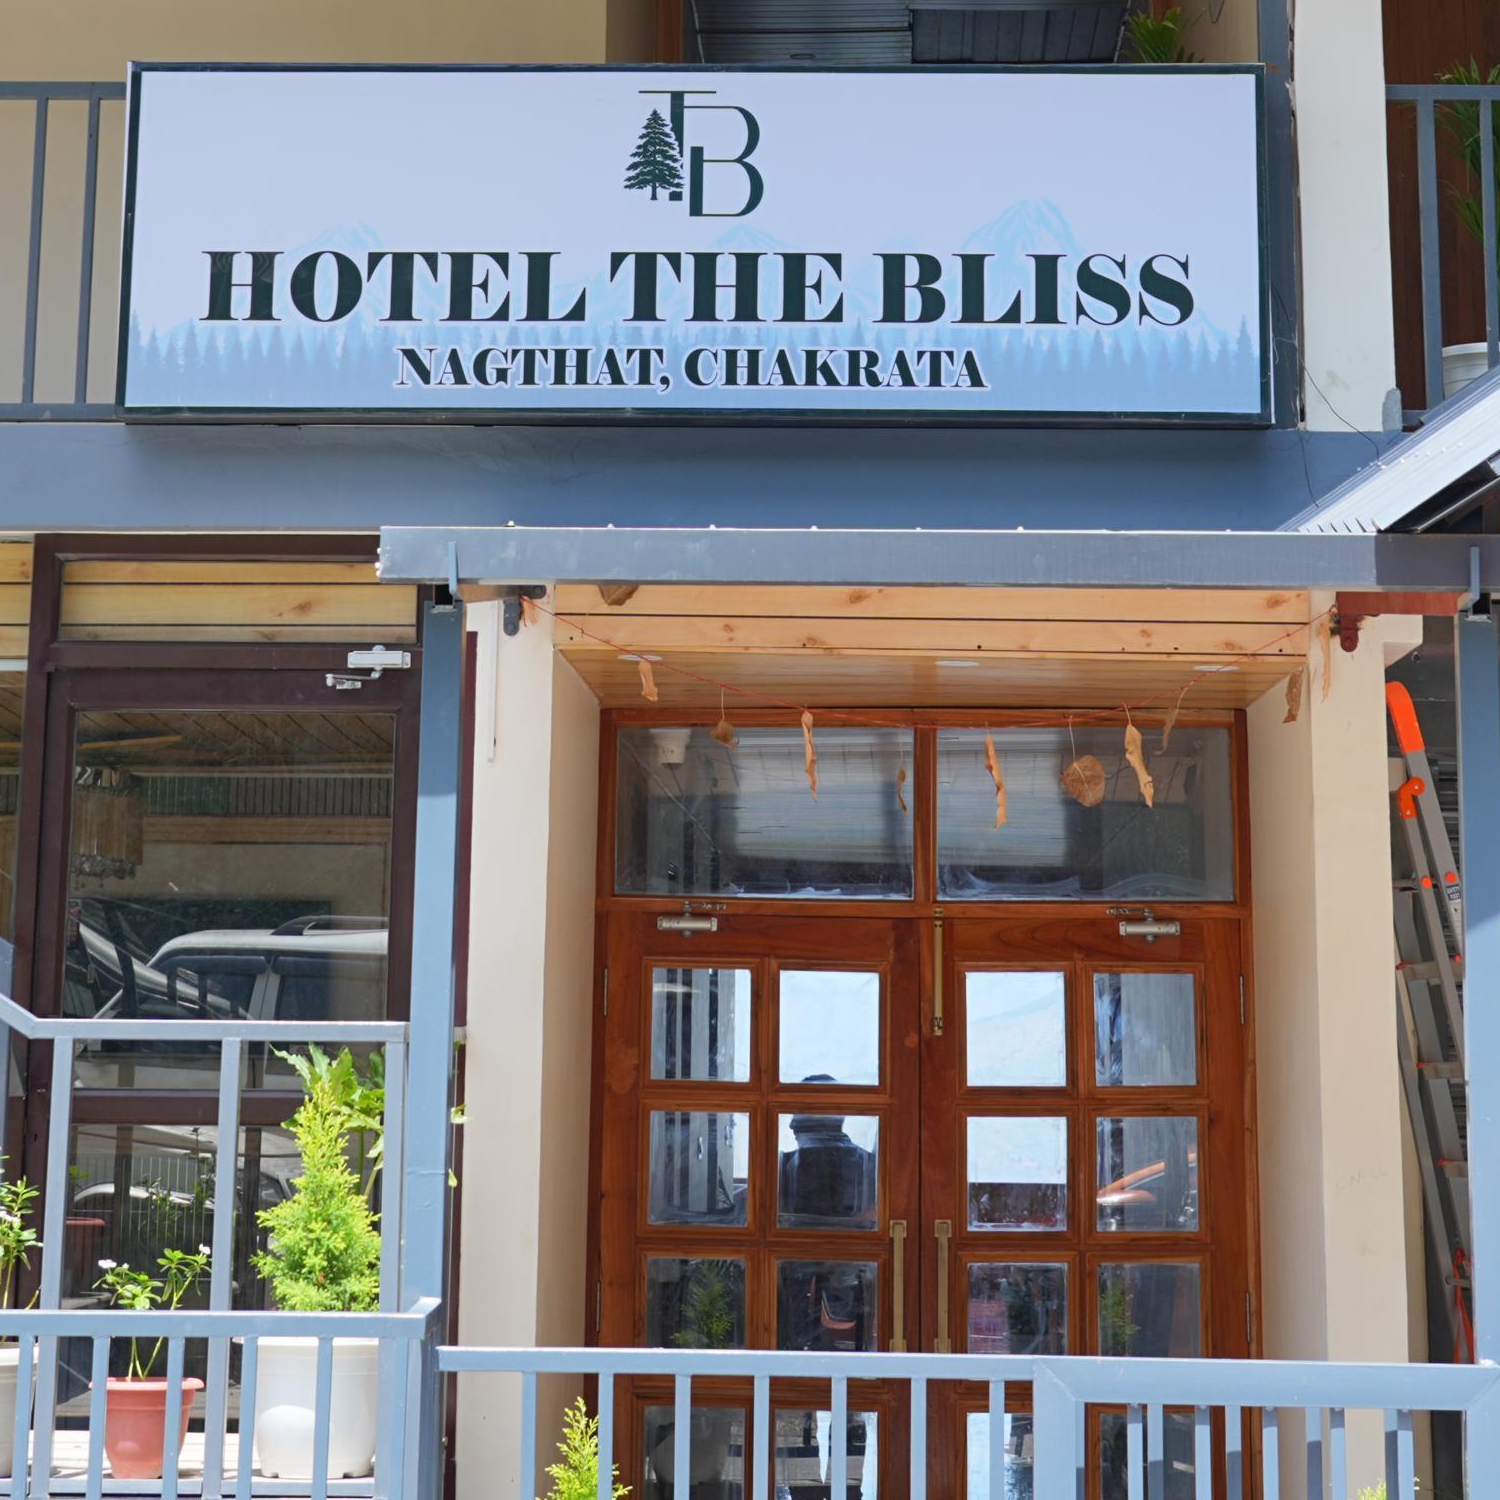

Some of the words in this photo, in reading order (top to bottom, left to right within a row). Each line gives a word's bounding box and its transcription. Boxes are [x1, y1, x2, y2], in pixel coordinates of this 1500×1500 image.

[199, 250, 587, 323] HOTEL
[609, 251, 844, 323] THE
[873, 252, 1195, 326] BLISS
[395, 347, 670, 393] NAGTHAT,
[684, 348, 987, 389] CHAKRATA
